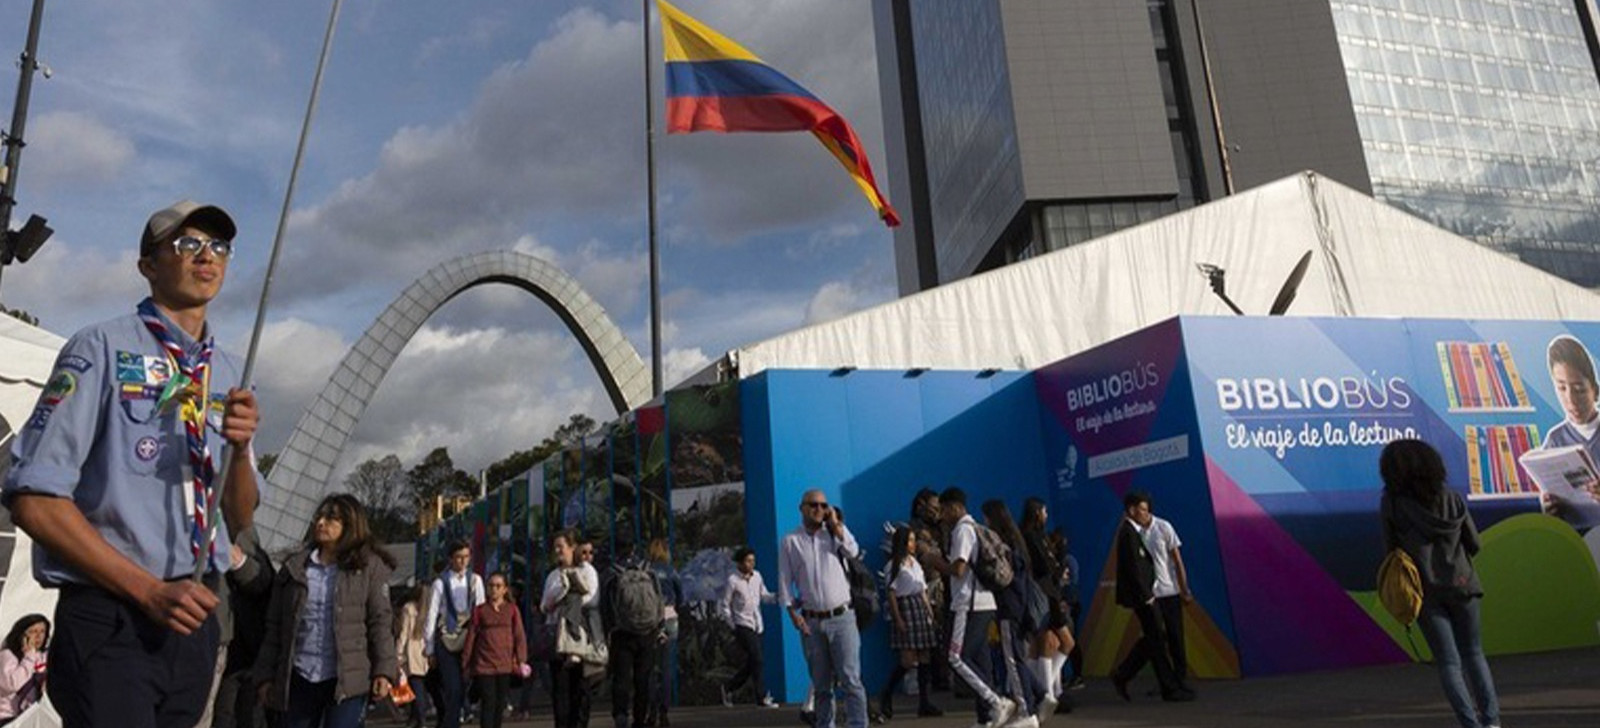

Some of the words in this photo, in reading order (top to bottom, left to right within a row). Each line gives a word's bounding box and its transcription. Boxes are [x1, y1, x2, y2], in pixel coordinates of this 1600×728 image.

[1066, 361, 1159, 411] BIBLIOBÚS
[1216, 369, 1411, 410] BIBLIOBÚS
[1225, 423, 1250, 449] El
[1250, 424, 1297, 459] viaje
[1298, 422, 1324, 446] de
[1324, 421, 1348, 445] la
